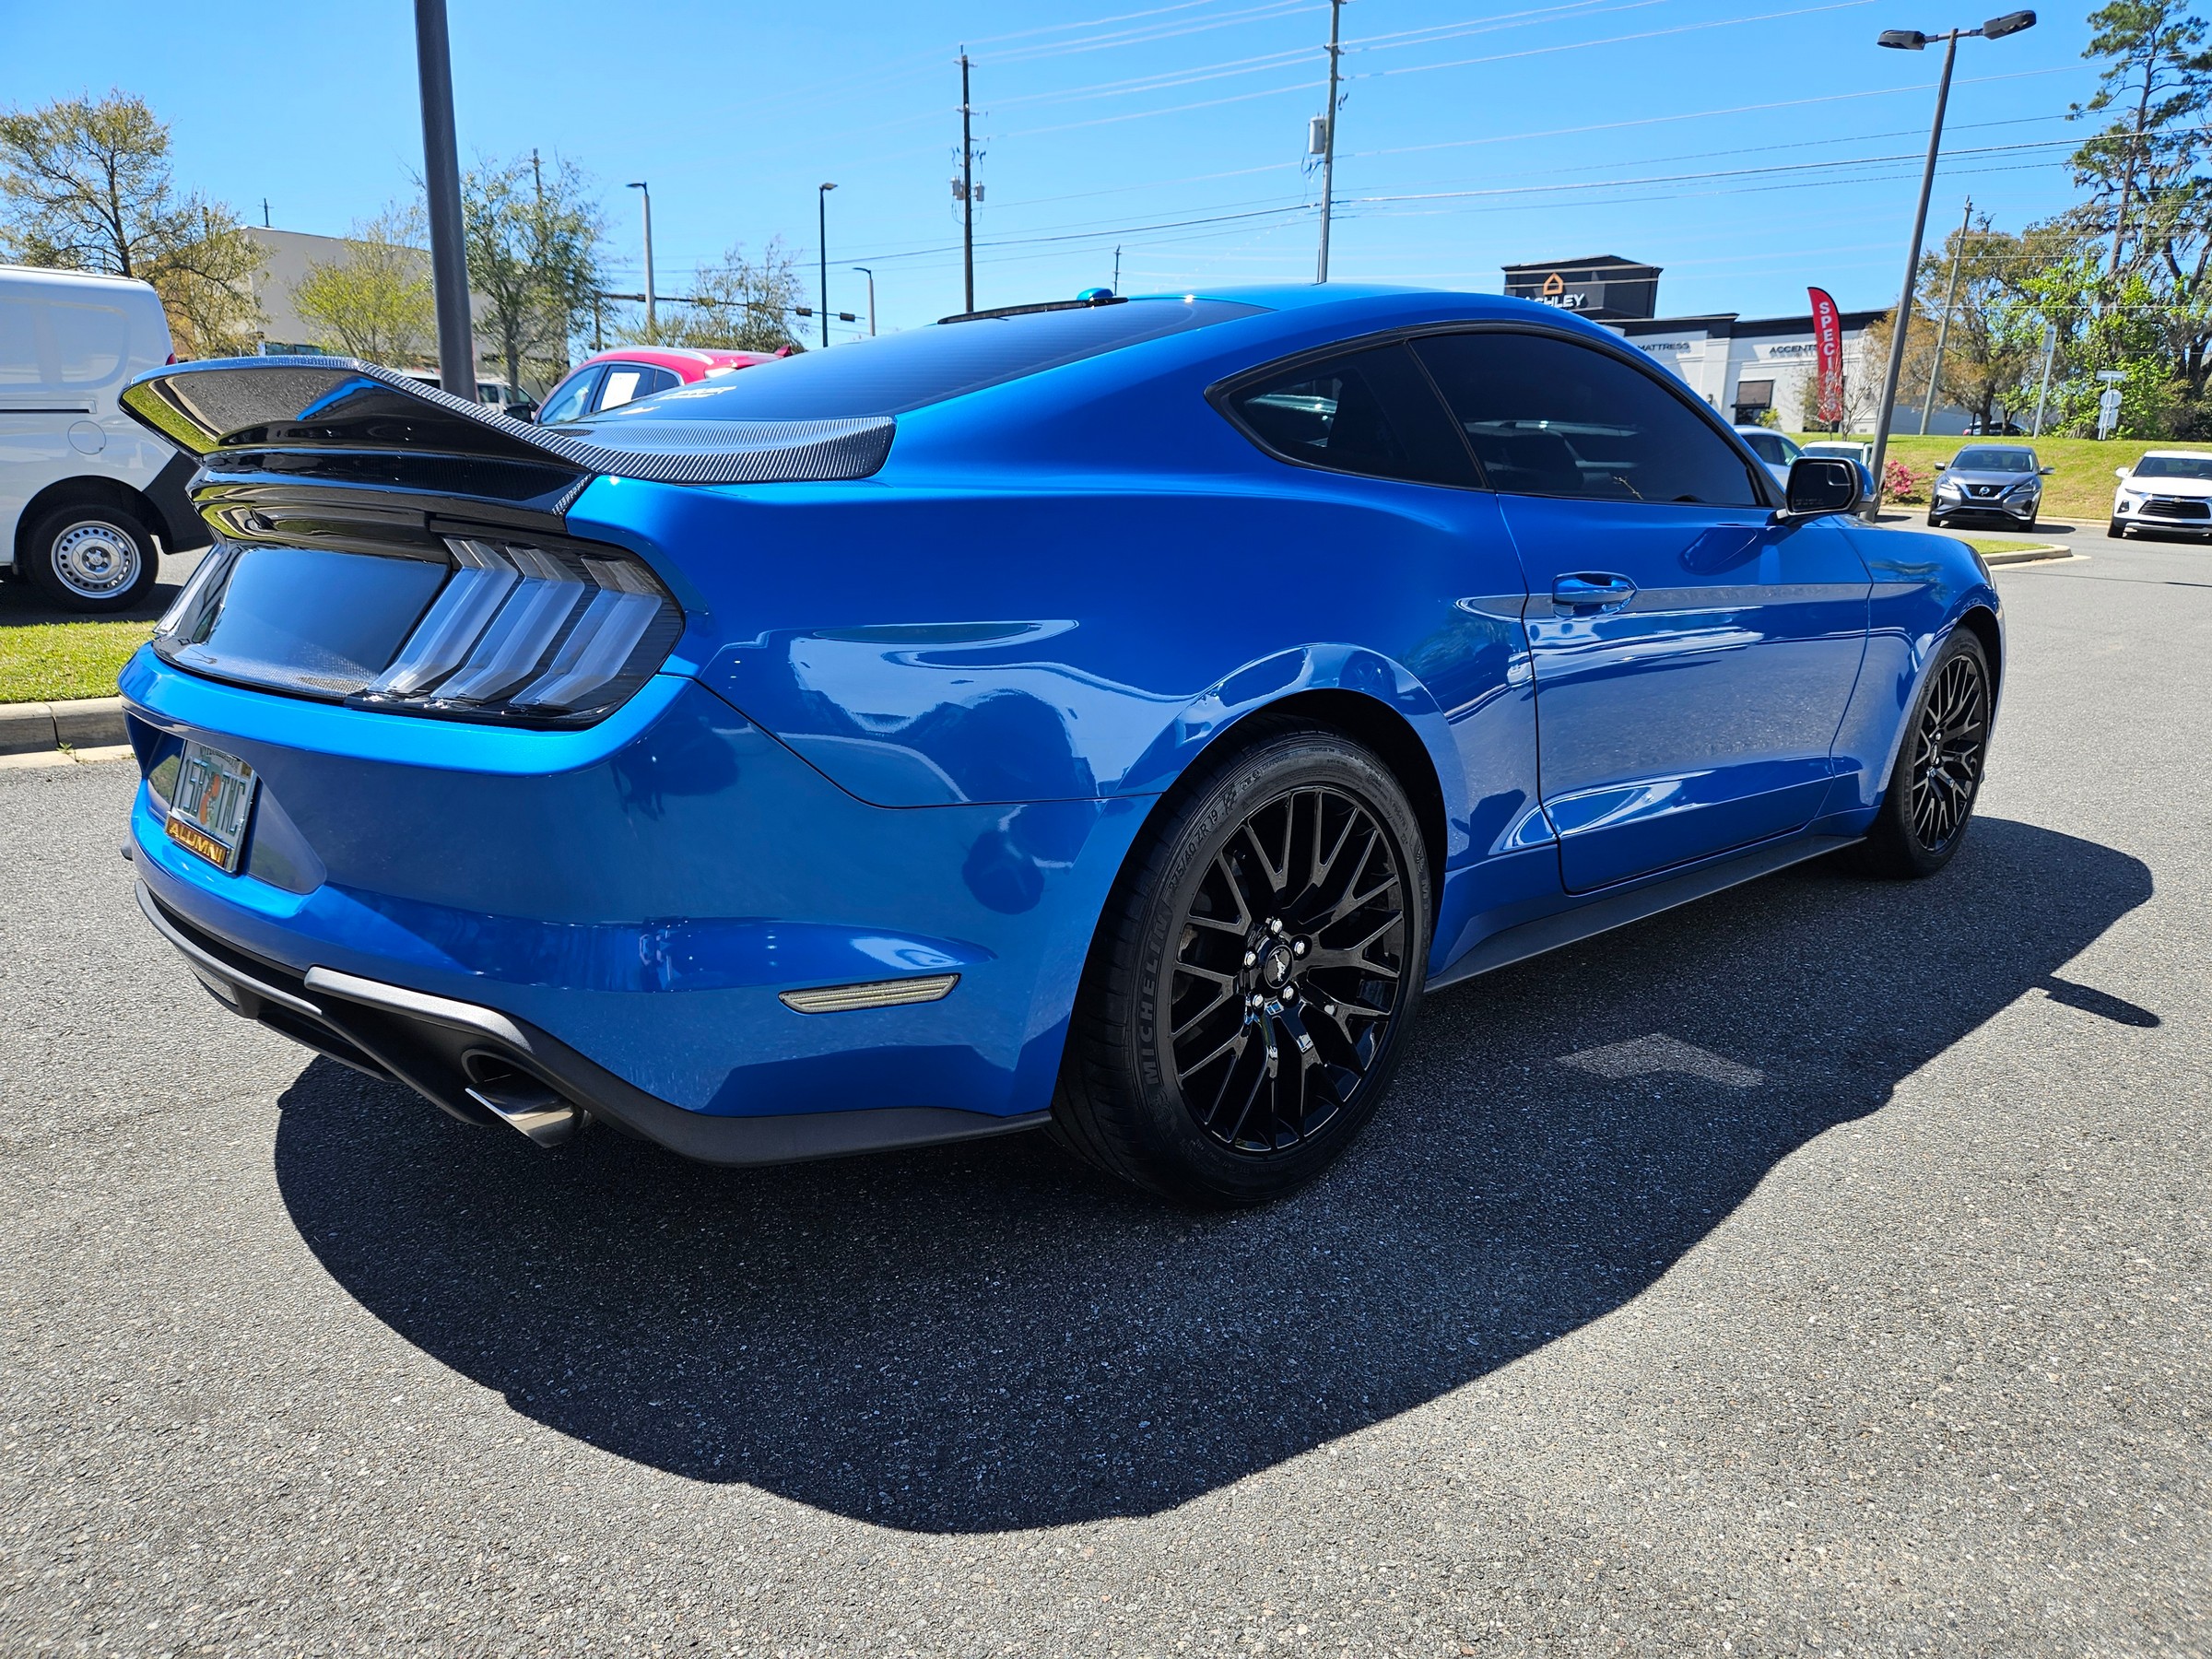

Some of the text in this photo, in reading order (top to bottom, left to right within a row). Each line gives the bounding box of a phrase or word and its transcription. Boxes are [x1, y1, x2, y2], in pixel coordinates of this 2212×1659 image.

[1637, 342, 1689, 352] MATTRESS
[1818, 301, 1836, 411] SPECIALS
[169, 822, 224, 863] ALUMNI
[1139, 912, 1168, 1086] MICHELIN
